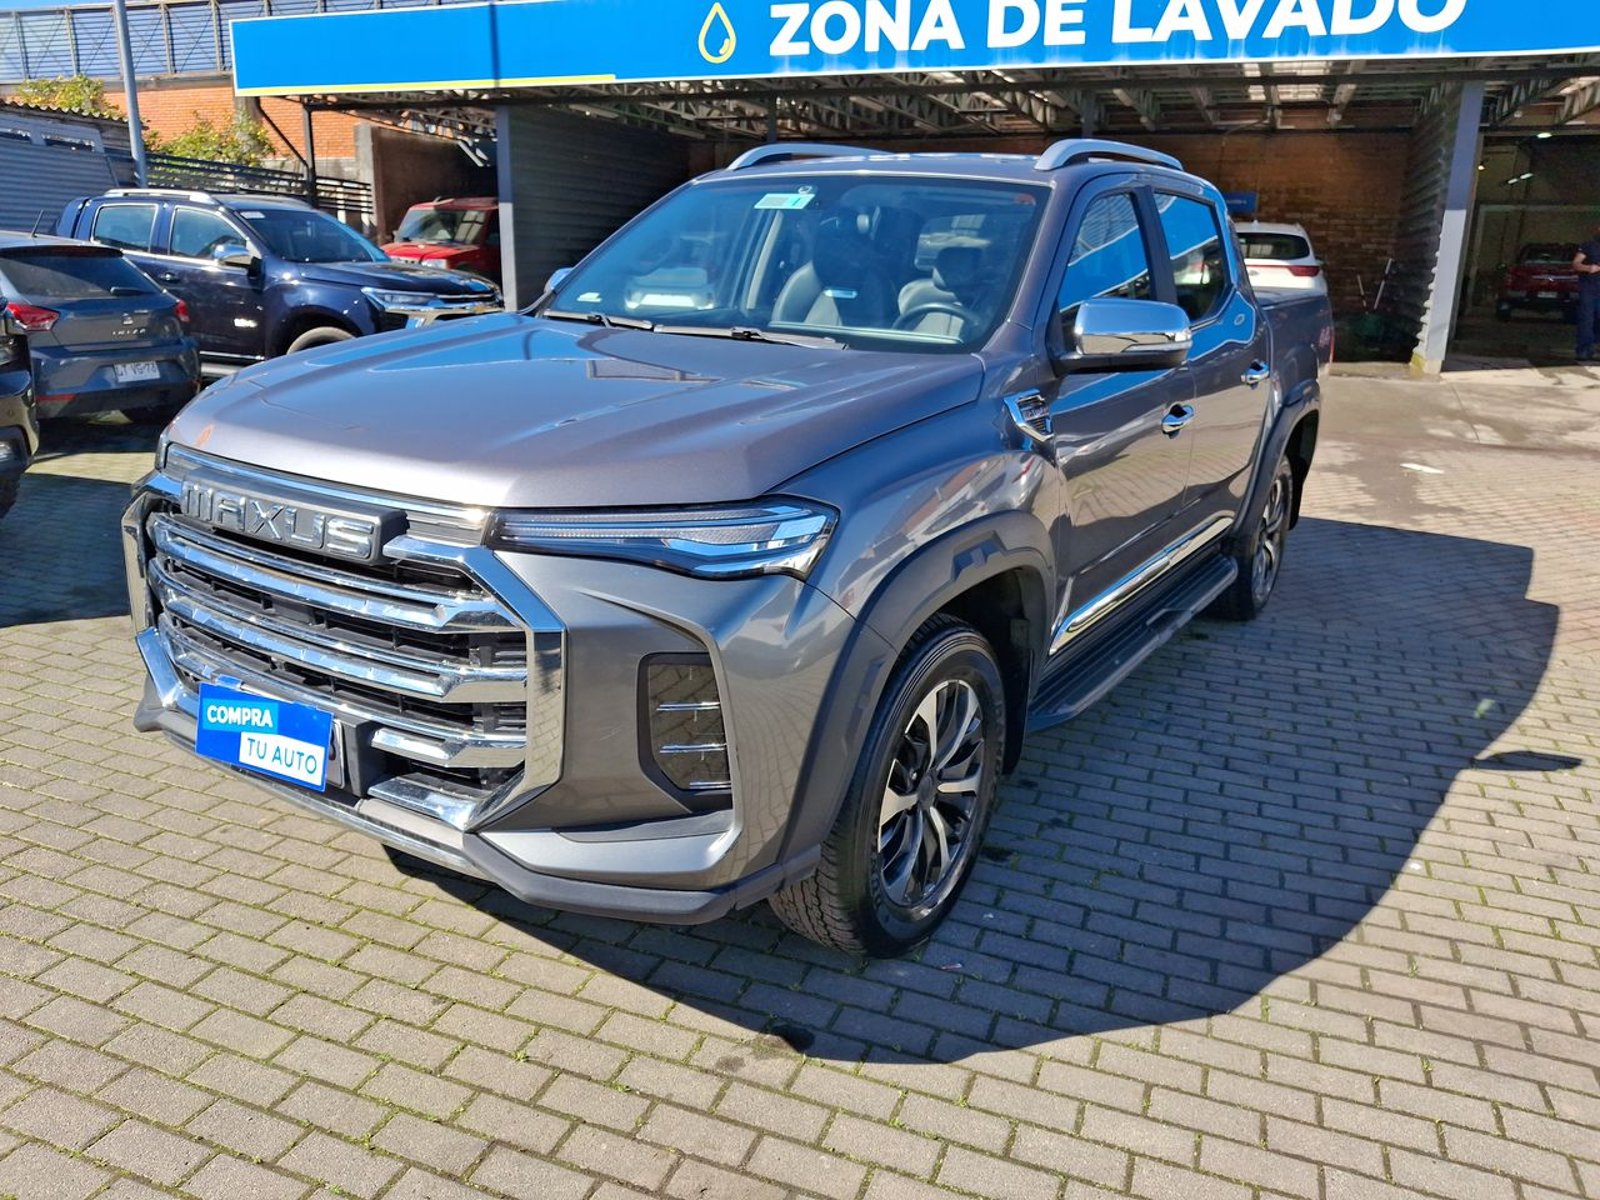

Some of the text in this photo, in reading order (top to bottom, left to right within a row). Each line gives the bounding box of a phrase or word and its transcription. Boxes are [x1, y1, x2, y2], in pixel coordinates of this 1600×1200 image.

[770, 0, 1467, 55] ZONA DE LAVADO
[182, 480, 374, 559] MAXUS
[206, 704, 273, 728] COMPRA
[247, 737, 267, 760] TU
[272, 745, 317, 775] AUTO
